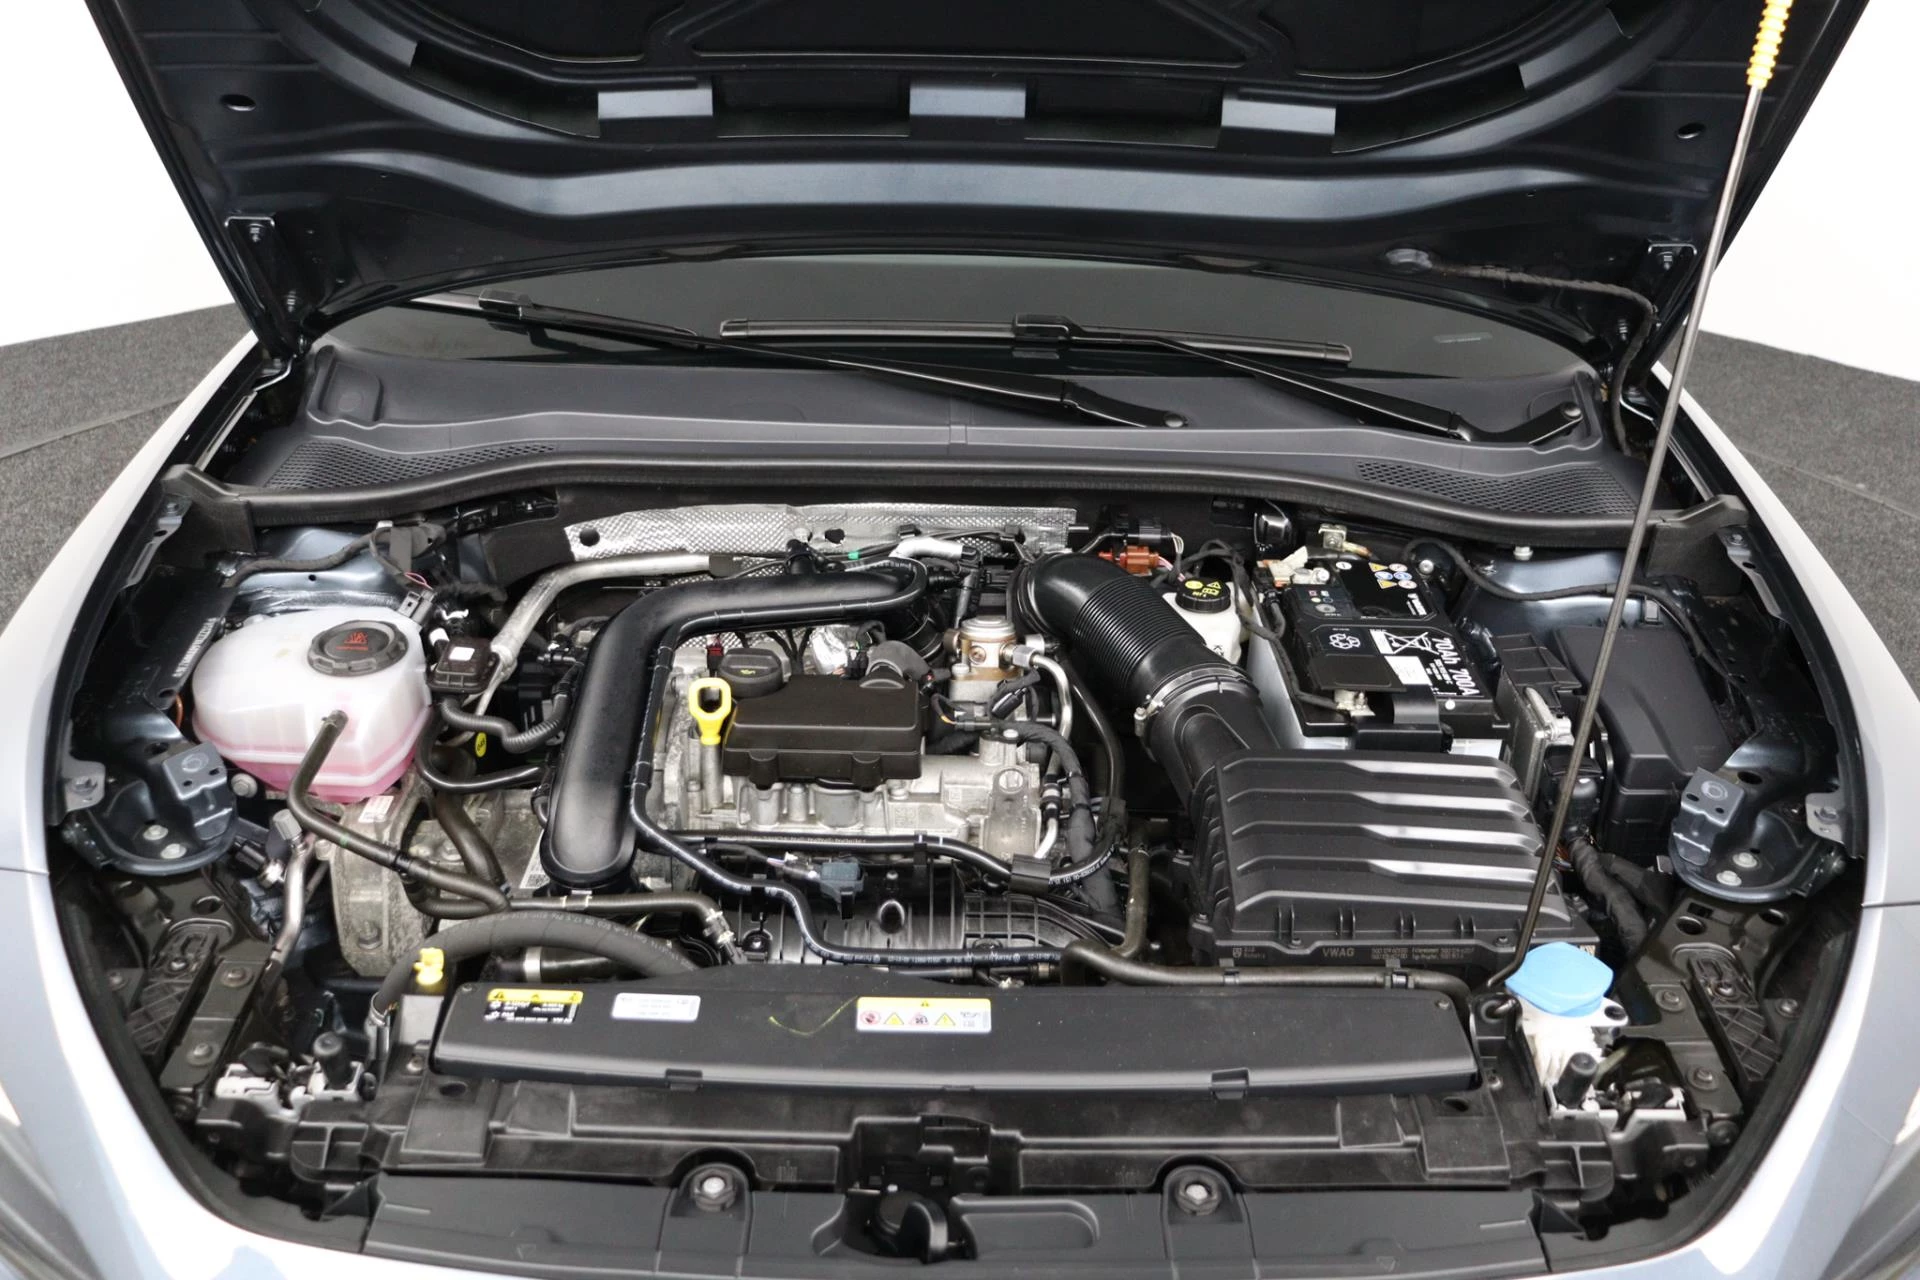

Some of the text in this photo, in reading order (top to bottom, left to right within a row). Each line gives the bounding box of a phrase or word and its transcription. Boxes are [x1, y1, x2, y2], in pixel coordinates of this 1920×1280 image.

[1431, 637, 1461, 664] 70Ah
[1449, 668, 1480, 696] 700A
[1322, 947, 1355, 959] VWAG
